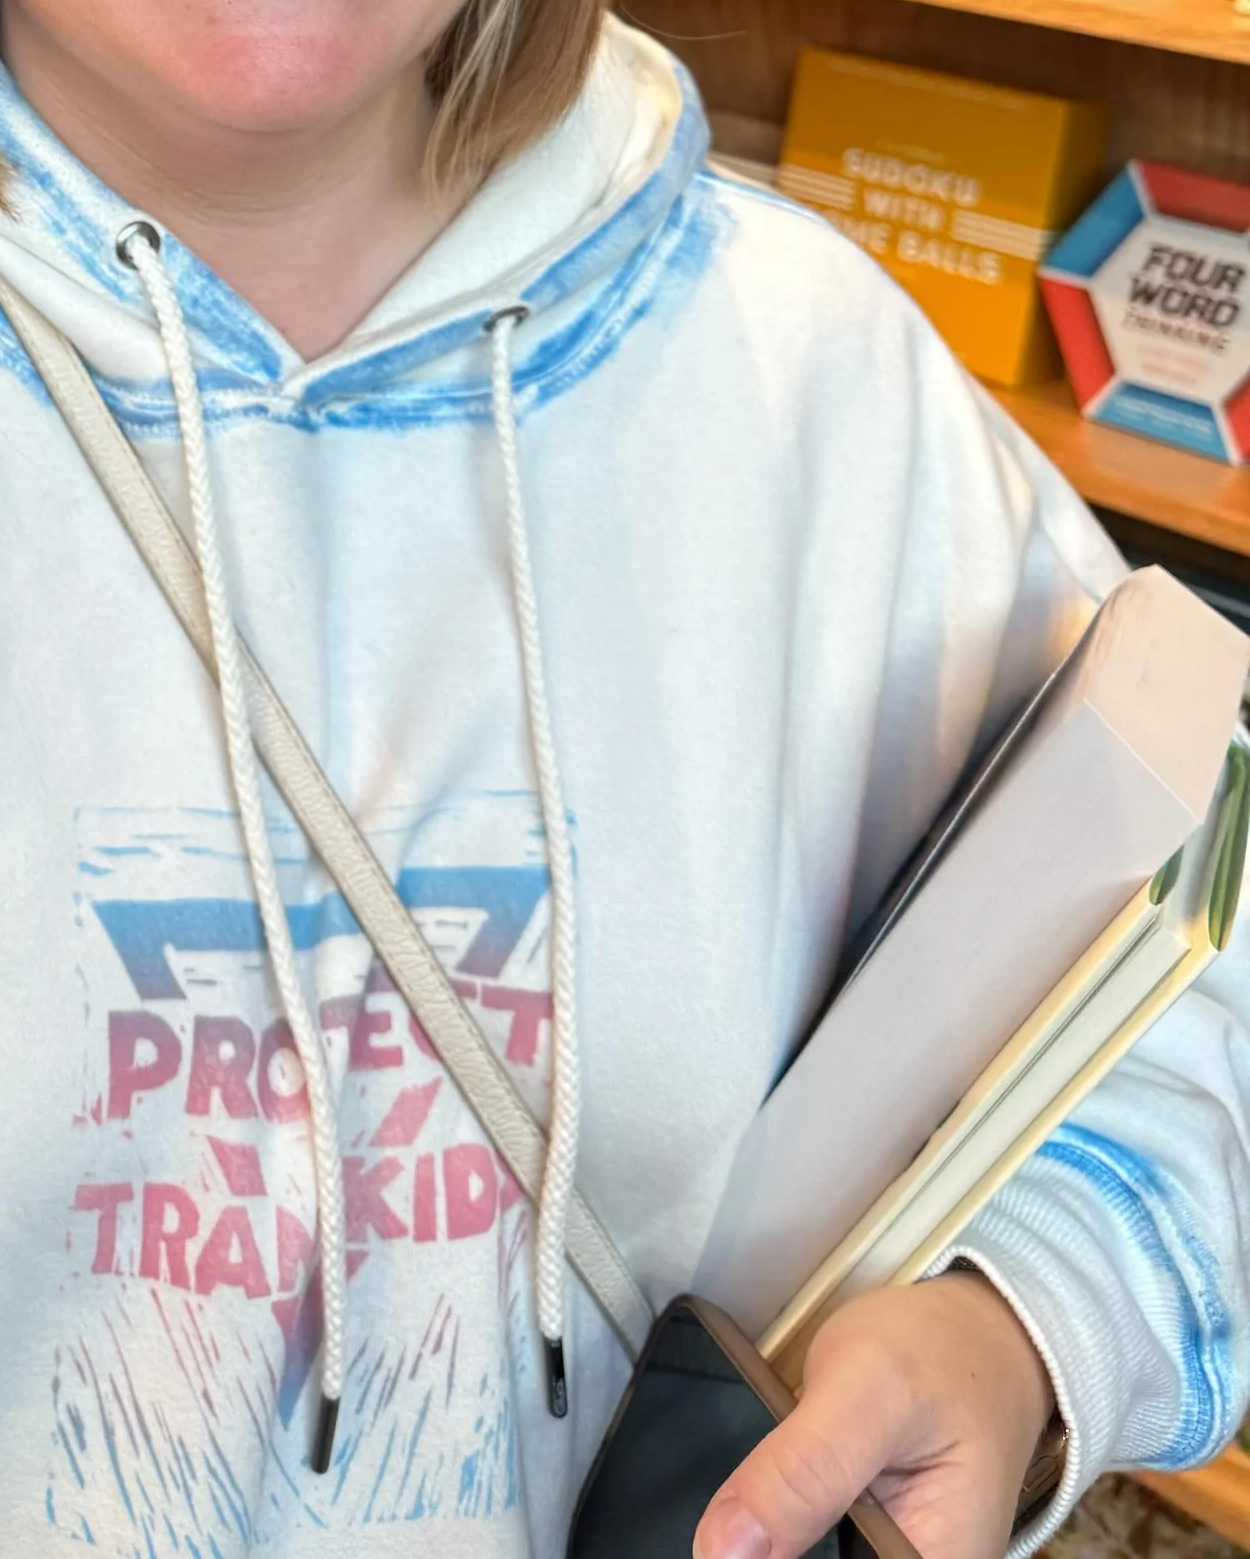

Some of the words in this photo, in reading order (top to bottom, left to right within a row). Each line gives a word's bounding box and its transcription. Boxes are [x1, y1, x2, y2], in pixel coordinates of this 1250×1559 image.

[841, 147, 982, 209] SUDOKU
[863, 187, 947, 233] WITH
[897, 228, 1004, 286] BALLS
[1141, 244, 1246, 294] FOUR
[1130, 274, 1240, 328] WORD
